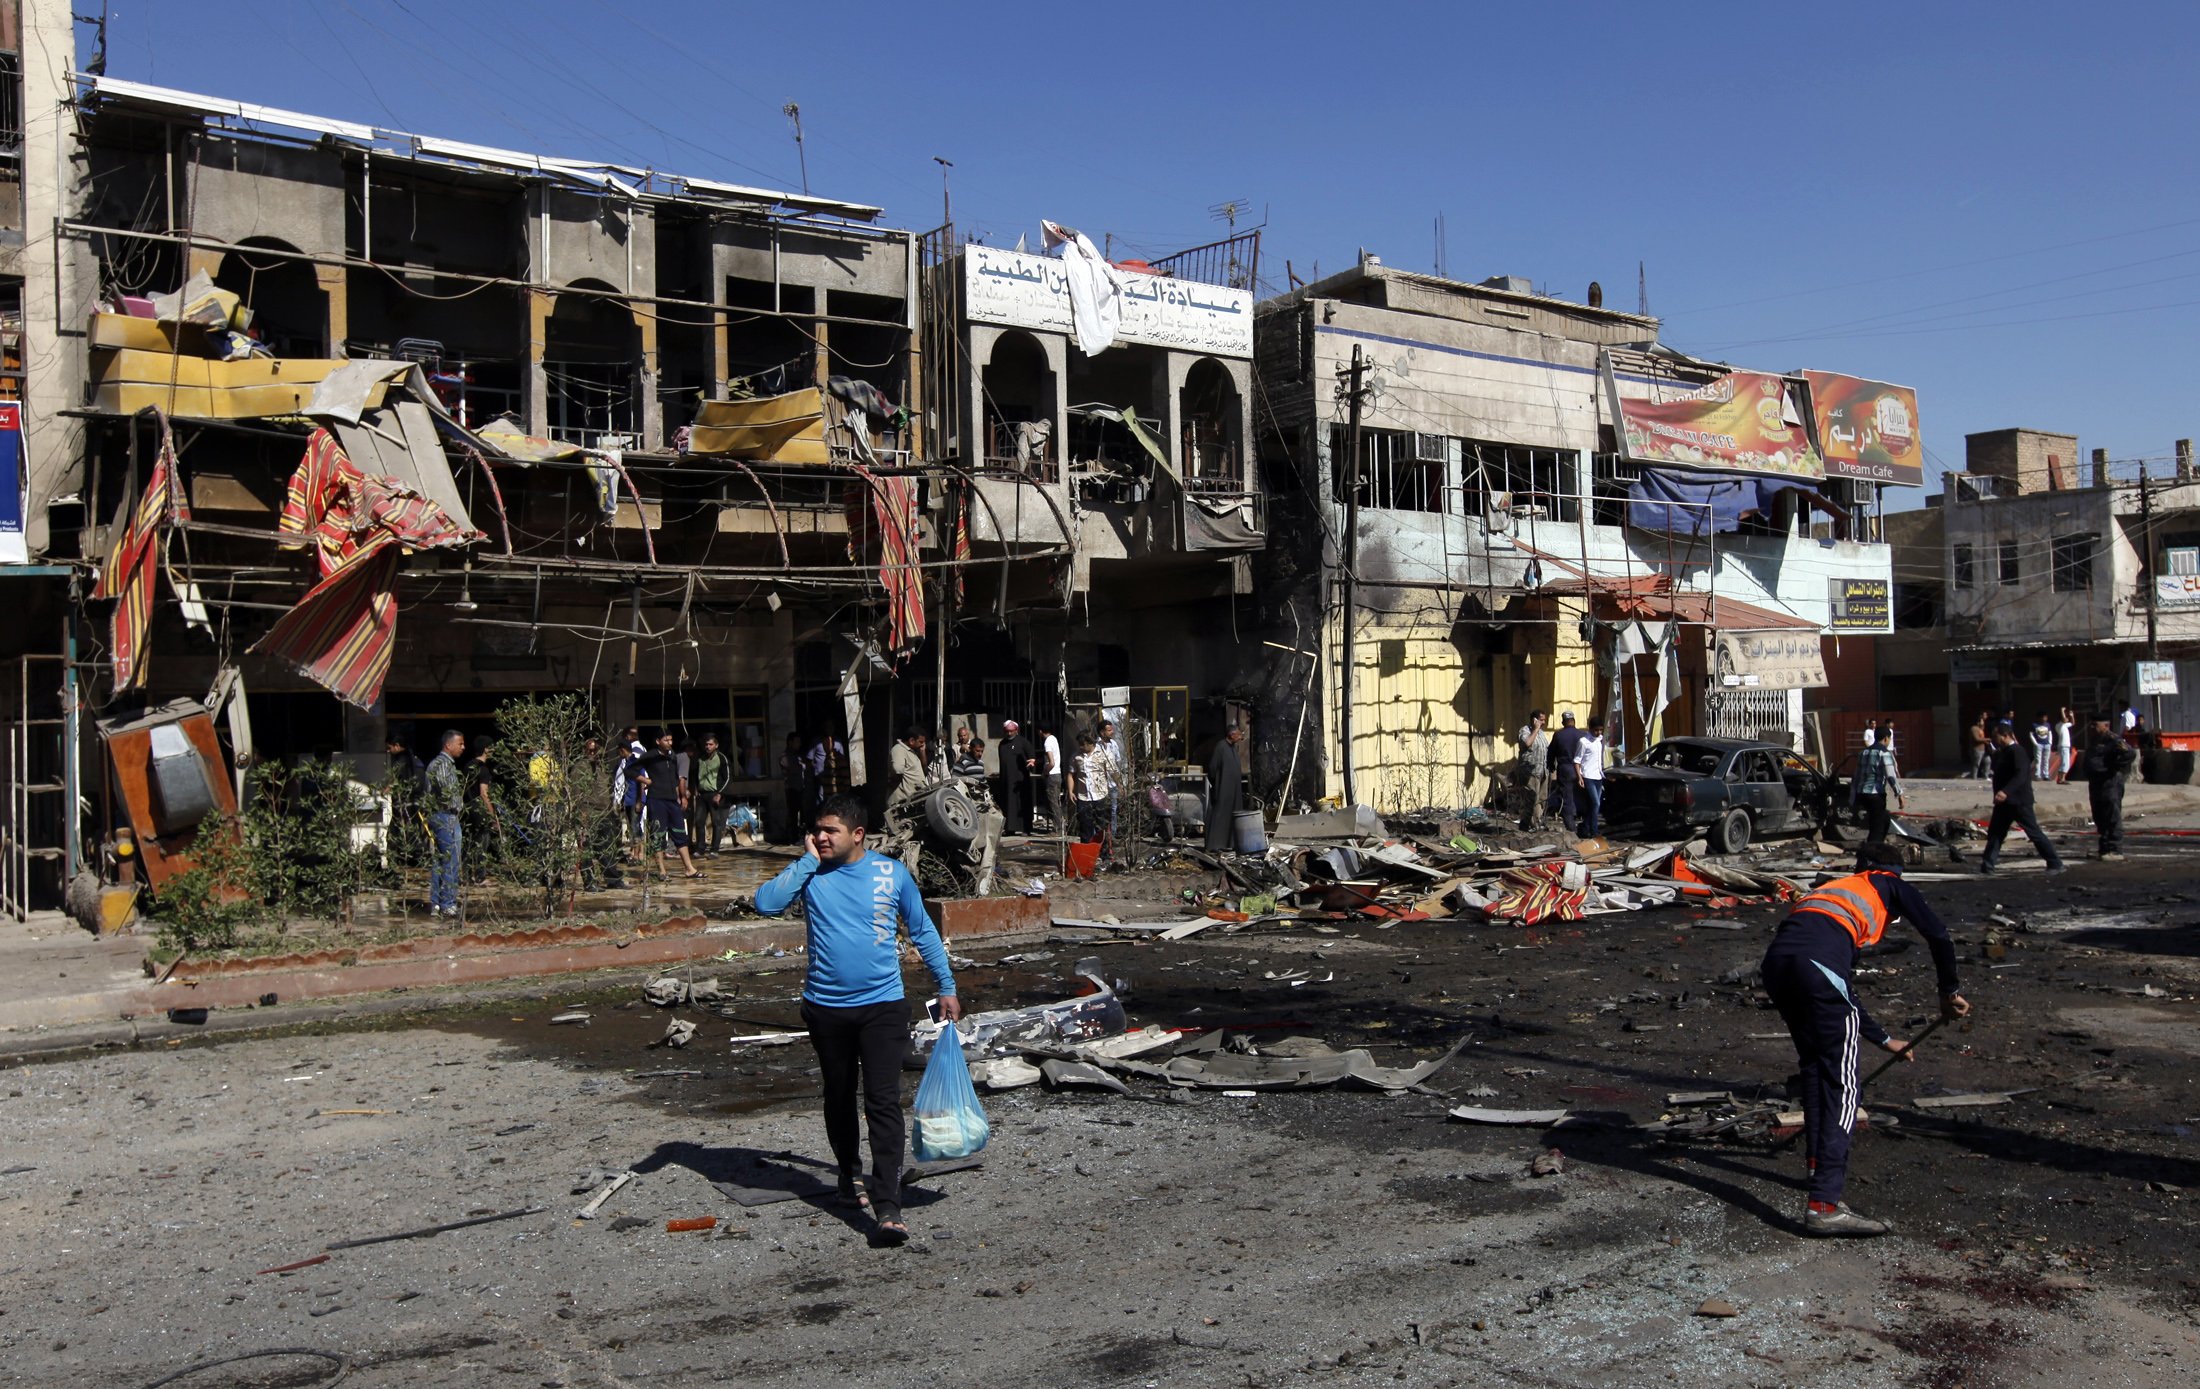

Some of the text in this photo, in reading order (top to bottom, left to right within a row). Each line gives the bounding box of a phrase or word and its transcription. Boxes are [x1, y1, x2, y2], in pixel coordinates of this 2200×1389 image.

[977, 251, 1049, 287] الطبية
[1167, 280, 1242, 319] عيادة
[1829, 424, 1872, 454] دريم
[1838, 461, 1894, 478] Dream Cafe
[872, 861, 895, 945] PRIMA
